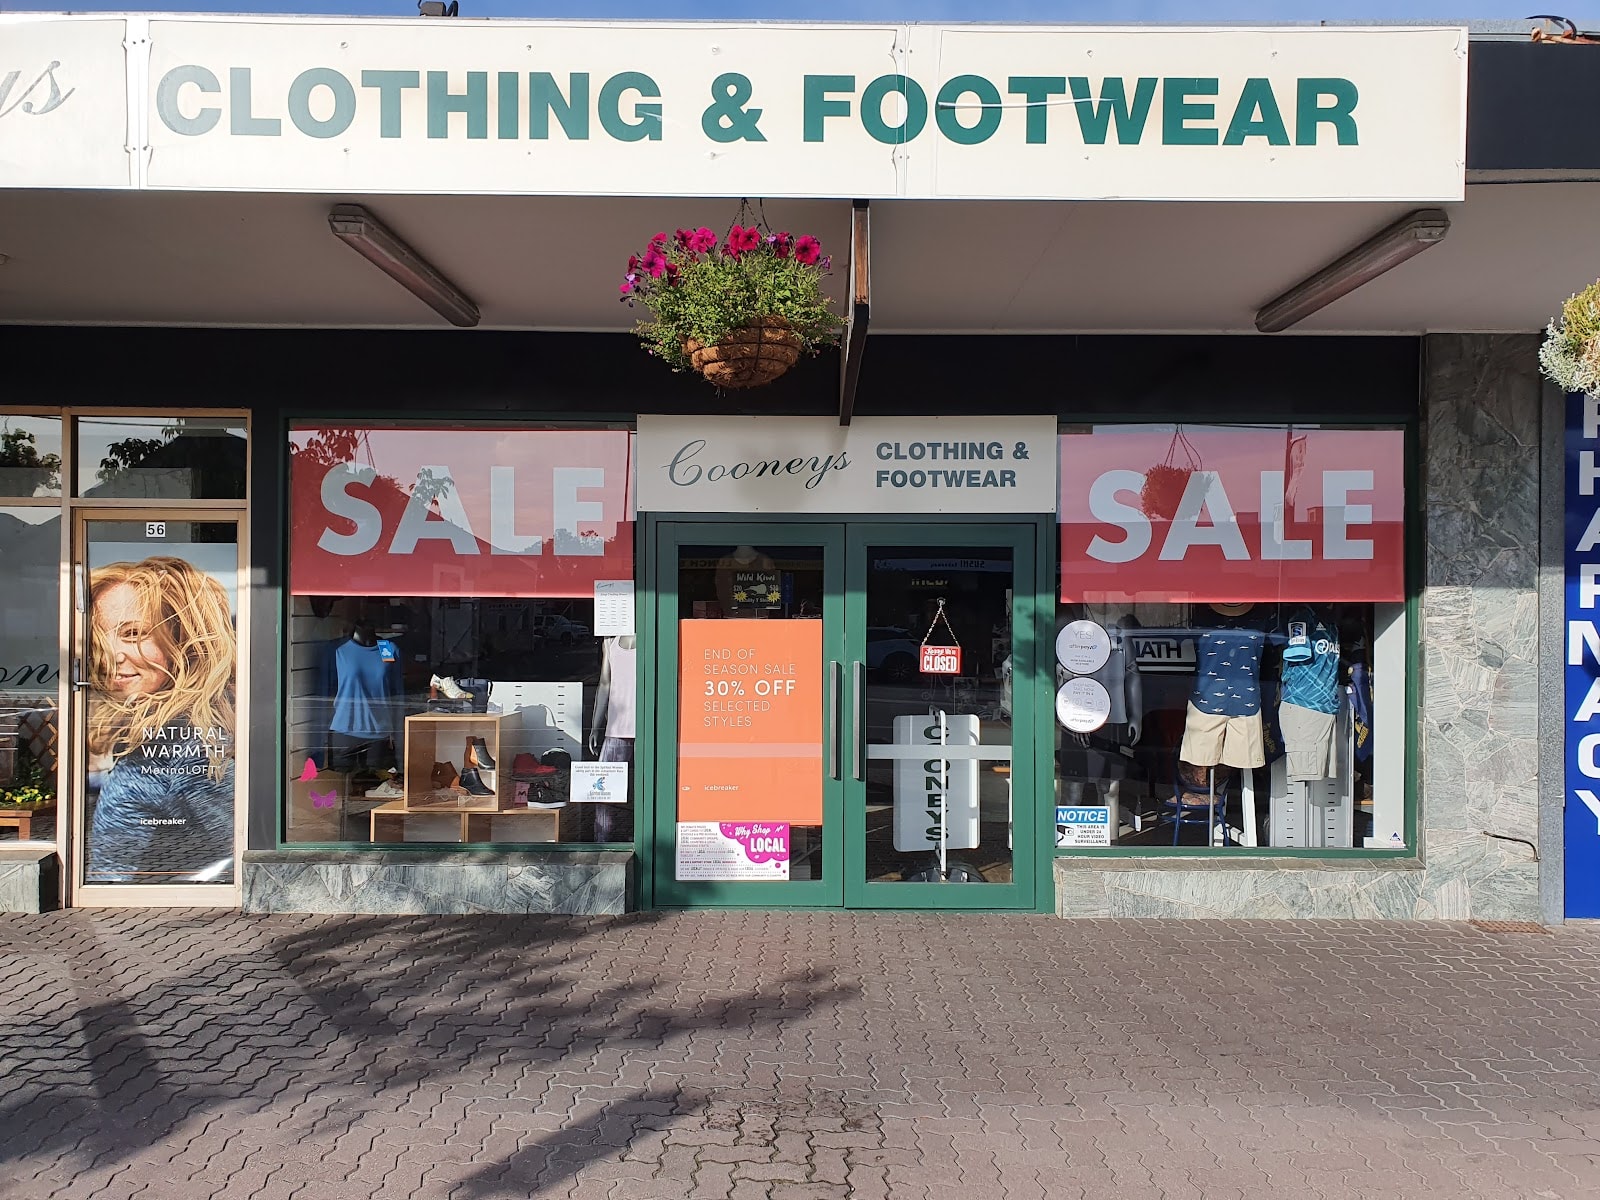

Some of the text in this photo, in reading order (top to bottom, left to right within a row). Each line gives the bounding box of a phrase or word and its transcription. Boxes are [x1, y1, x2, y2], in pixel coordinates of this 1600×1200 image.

[156, 64, 1359, 146] CLOTHING & FOOTWEAR
[876, 441, 1030, 461] CLOTHING &
[661, 439, 852, 490] Cooneys
[876, 469, 1017, 488] FOOTWEAR
[317, 461, 605, 557] SALE
[1085, 469, 1375, 564] SALE
[147, 523, 165, 536] 56
[736, 573, 775, 582] Wild Kiwi
[1073, 630, 1095, 640] YES!
[704, 648, 756, 660] END OF
[704, 664, 796, 675] SEASON SALE
[923, 655, 957, 671] CLOSED
[704, 679, 796, 696] 30% OFF
[704, 700, 771, 712] SELECTED
[703, 716, 753, 727] STYLES
[142, 726, 226, 740] NATURAL
[141, 744, 225, 758] WARMTH
[140, 818, 187, 826] icebreaker
[1057, 810, 1106, 822] NOTICE
[735, 824, 771, 838] Why Shop
[750, 838, 786, 853] LOCAL
